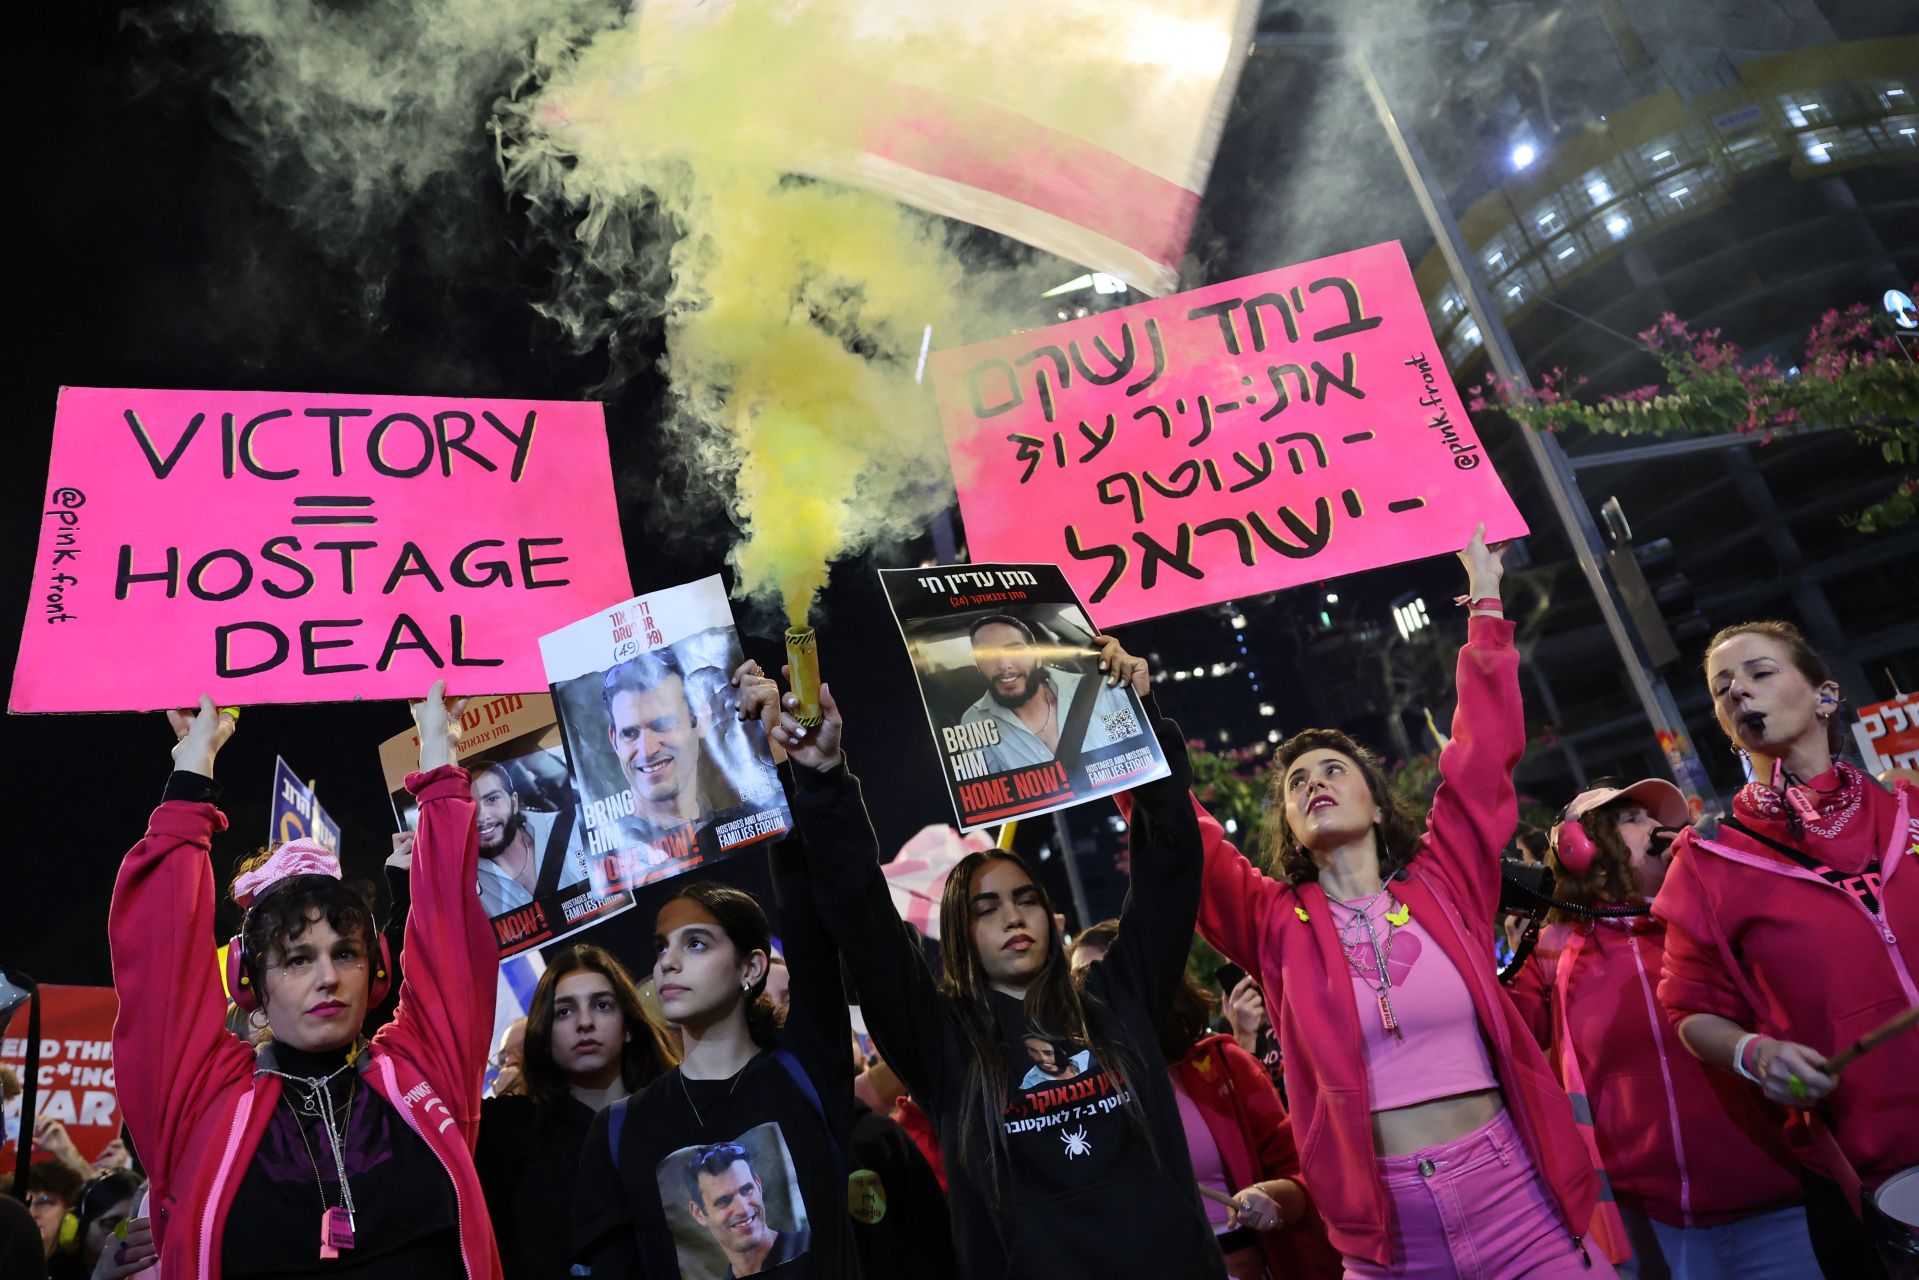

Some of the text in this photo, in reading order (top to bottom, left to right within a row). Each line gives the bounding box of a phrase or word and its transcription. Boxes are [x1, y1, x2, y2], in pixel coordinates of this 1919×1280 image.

[967, 277, 1384, 422] ביחד נשקם
[1404, 352, 1480, 470] @pink.front
[123, 408, 538, 483] VICTORY
[1097, 433, 1330, 524] העוטף
[45, 486, 86, 625] @pink.front
[1064, 488, 1365, 604] ישראל
[114, 536, 571, 601] HOSTAGE
[918, 571, 1038, 595] מתן עדיין חי
[215, 613, 504, 679] DEAL
[612, 622, 638, 644] DRO
[492, 724, 510, 740] מתן
[942, 718, 1000, 754] BRING
[950, 750, 989, 782] HIM
[1085, 745, 1152, 774] HOSTAGES AND MISSING
[1088, 754, 1155, 785] FAMILIES FORUM
[959, 760, 1070, 813] HOME NOW!
[583, 789, 636, 830] BRING
[715, 807, 782, 836] HOSTAGES AND MISSING
[587, 822, 622, 857] HIM
[718, 815, 786, 849] FAMILIES FORUM
[495, 900, 548, 945] NOW!
[564, 900, 600, 923] FAMILIES
[64, 1039, 114, 1060] THI
[1003, 1109, 1070, 1134] לאוקטובר
